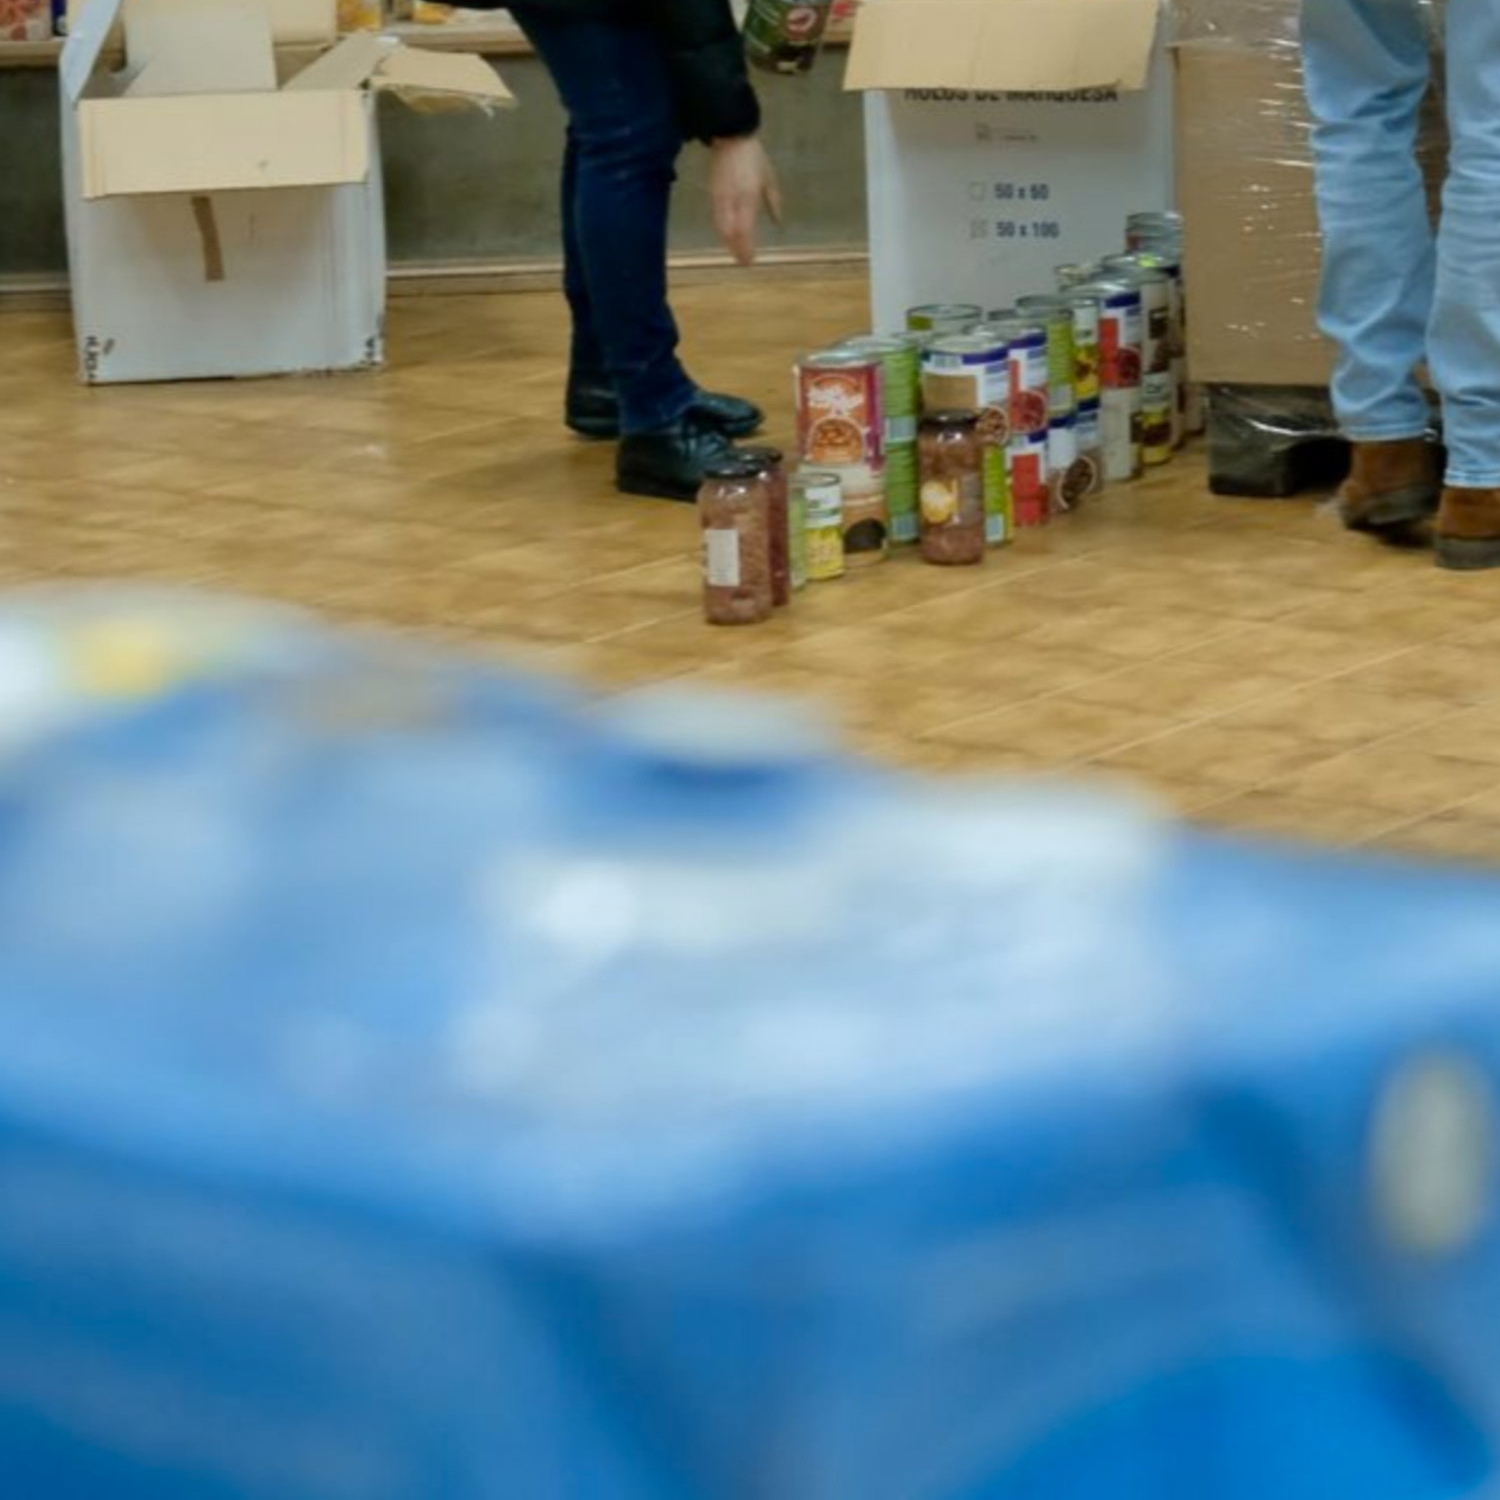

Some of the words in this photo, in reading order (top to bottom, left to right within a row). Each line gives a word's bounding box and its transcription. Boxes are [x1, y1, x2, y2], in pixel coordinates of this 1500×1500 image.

[994, 183, 1014, 200] 50
[1017, 187, 1026, 200] x
[996, 221, 1016, 238] 50
[1019, 225, 1028, 238] x
[1032, 222, 1060, 239] 100
